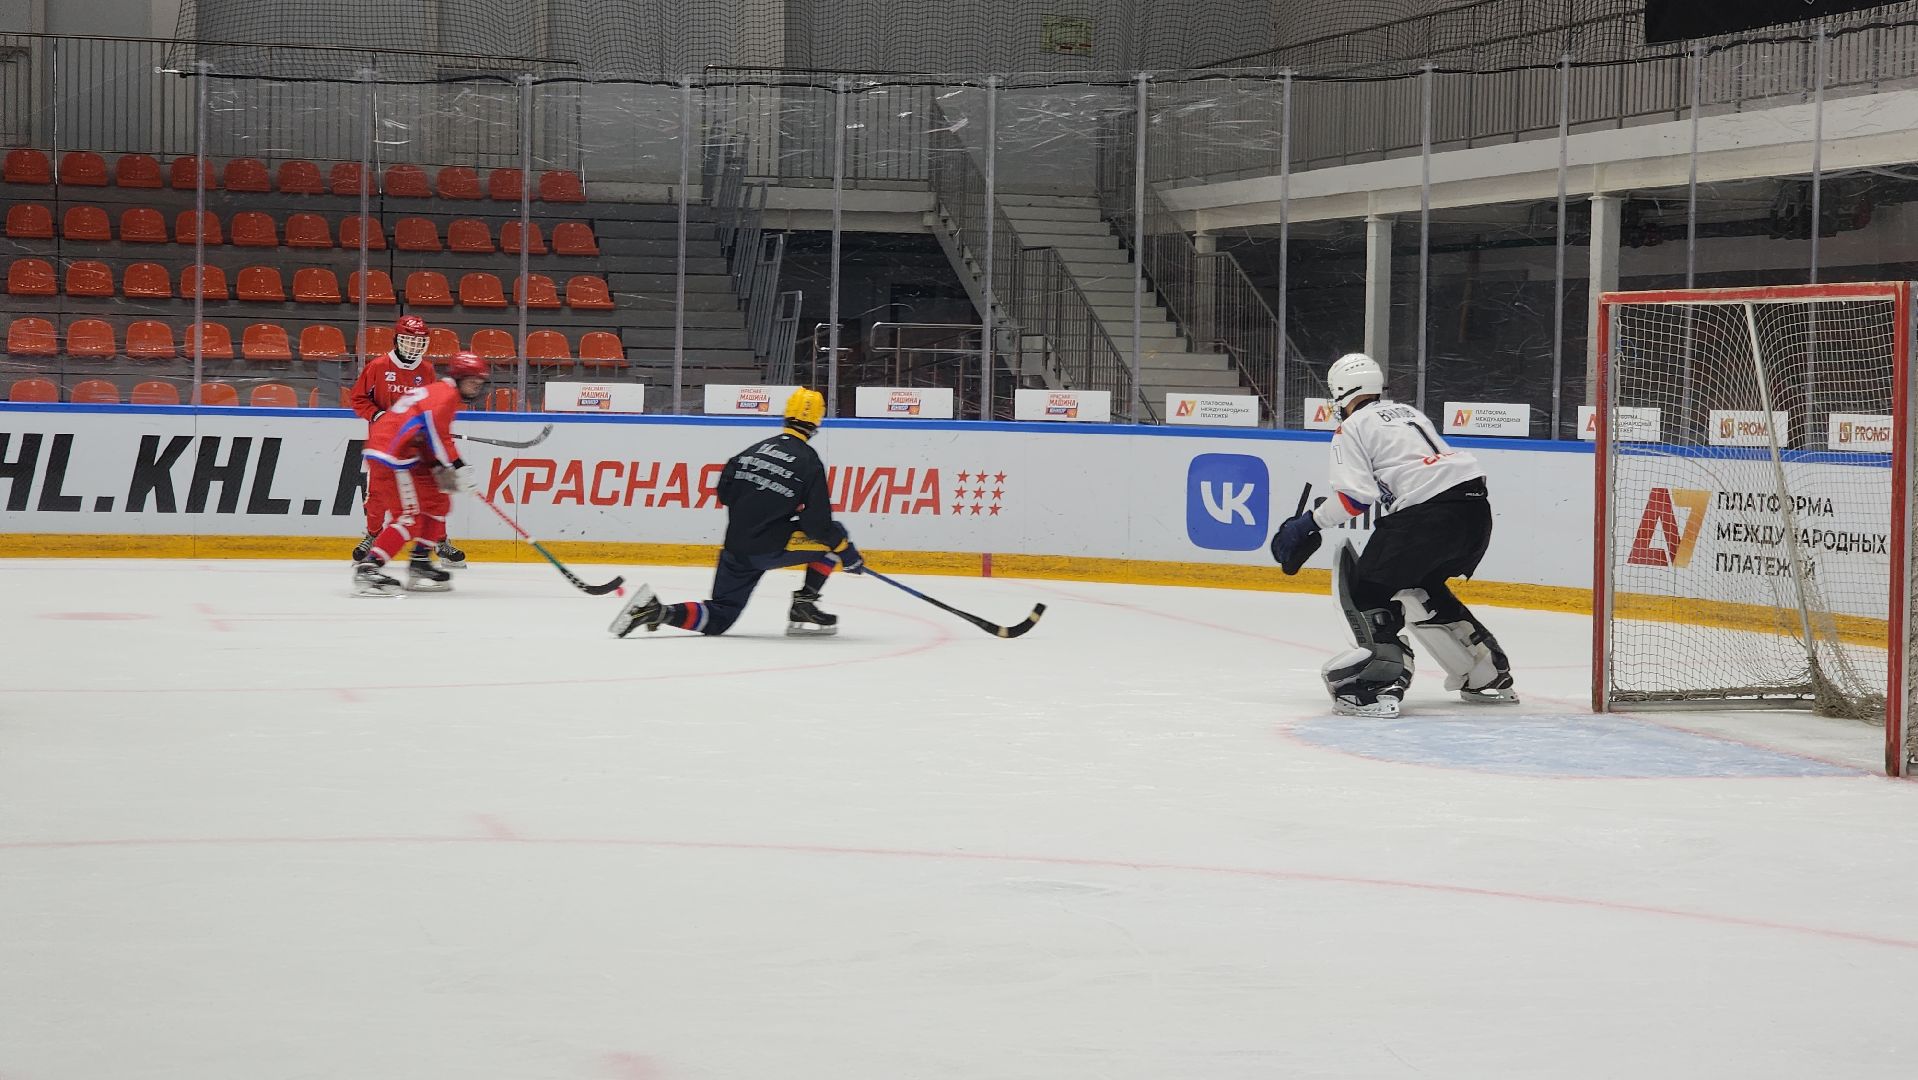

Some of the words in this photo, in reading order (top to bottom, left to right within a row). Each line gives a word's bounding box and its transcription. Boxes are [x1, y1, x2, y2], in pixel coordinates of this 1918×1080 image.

[1737, 421, 1768, 436] PROM
[486, 456, 729, 509] КРАСНАЯ
[826, 466, 942, 516] ШИНА
[1200, 480, 1256, 526] VK
[1716, 522, 1887, 555] МЕЖДУАРОДНЫХ
[1715, 552, 1817, 581] ПЛАТЕЖЙ
